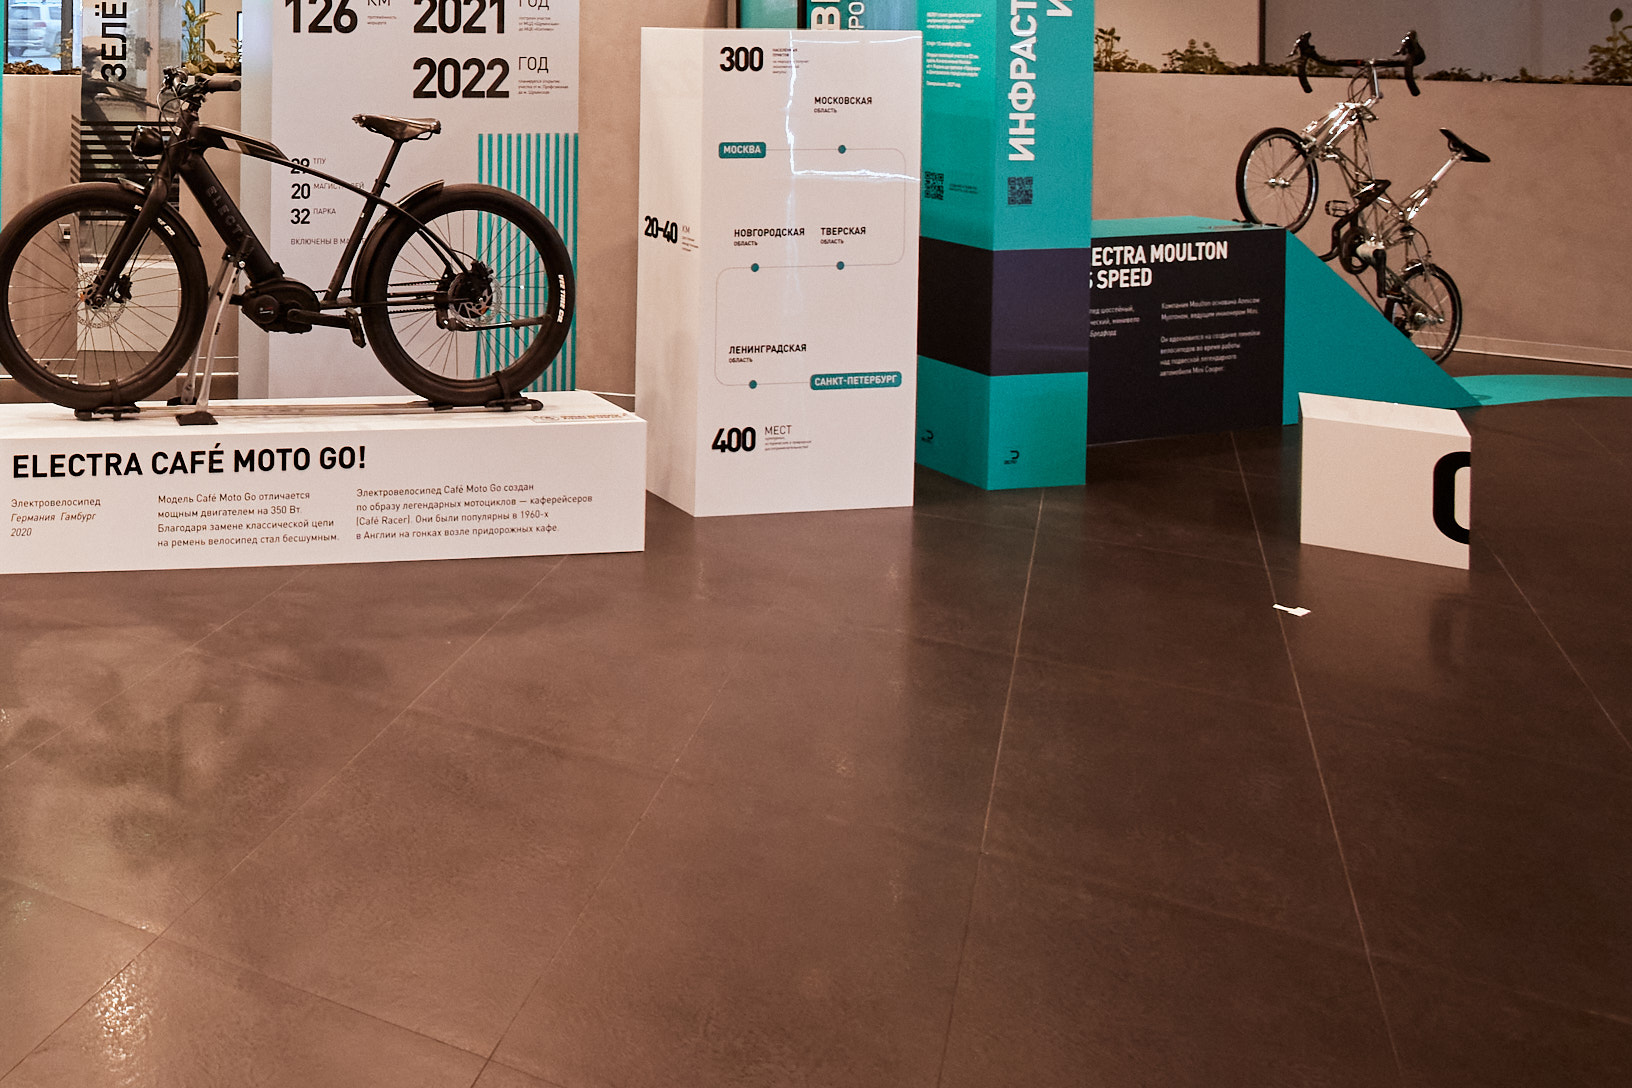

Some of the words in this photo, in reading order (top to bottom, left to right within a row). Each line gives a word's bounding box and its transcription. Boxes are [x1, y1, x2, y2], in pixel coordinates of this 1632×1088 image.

[720, 47, 764, 72] 300
[413, 57, 510, 99] 2022
[518, 56, 549, 74] ГОД
[814, 96, 874, 106] МОСКОВСКАЯ
[723, 144, 763, 155] МОСКВА
[291, 183, 312, 201] 20
[290, 208, 312, 226] 32
[313, 207, 337, 216] ПАРКА
[733, 227, 806, 239] НОВГОРОДСКАЯ
[820, 226, 868, 237] ТВЕРСКАЯ
[290, 238, 332, 247] ВКЛЮЧЕНЫ
[332, 238, 339, 247] В
[733, 240, 759, 248] ОБЛАСТЬ
[820, 238, 845, 246] ОБЛАСТЬ
[1092, 246, 1147, 267] ECTRA
[1151, 241, 1228, 263] MOULTON
[1097, 268, 1153, 290] SPEED
[728, 343, 808, 356] ЛЕНИНГРАДСКАЯ
[728, 357, 754, 365] ОБЛАСТЬ
[814, 373, 899, 388] САНКТ-ПЕТЕРБУРГ
[712, 427, 757, 453] 400
[765, 424, 793, 436] МЕСТ
[14, 453, 143, 479] ELECTRA
[152, 443, 225, 475] CAFÉ
[234, 448, 311, 473] MOTO
[320, 446, 366, 470] GO!
[356, 487, 441, 497] Электровелосипед
[443, 484, 463, 493] Café
[466, 484, 487, 492] Moto
[489, 483, 501, 491] Go
[11, 498, 100, 507] Электровелосипед
[158, 495, 193, 504] Модель
[196, 493, 216, 502] Café
[219, 493, 241, 501] Moto
[244, 492, 256, 501] Go
[258, 492, 309, 500] отличается
[369, 501, 400, 512] образу
[402, 501, 461, 509] легендарных
[463, 498, 516, 507] мотоциклов
[529, 495, 592, 504] каферейсеров
[10, 513, 55, 522] Германия
[60, 511, 96, 522] Гамбург
[200, 508, 254, 517] двигателем
[270, 505, 286, 514] 350
[356, 516, 378, 525] (Café
[415, 514, 432, 523] Они
[435, 513, 458, 522] были
[461, 513, 509, 521] популярны
[520, 509, 548, 518] 1960-х
[10, 527, 32, 536] 2020
[157, 523, 206, 532] Благодаря
[245, 519, 308, 529] классической
[363, 530, 396, 539] Англии
[443, 528, 469, 536] возле
[472, 526, 533, 535] придорожных
[171, 539, 205, 547] ремень
[208, 537, 257, 545] велосипед
